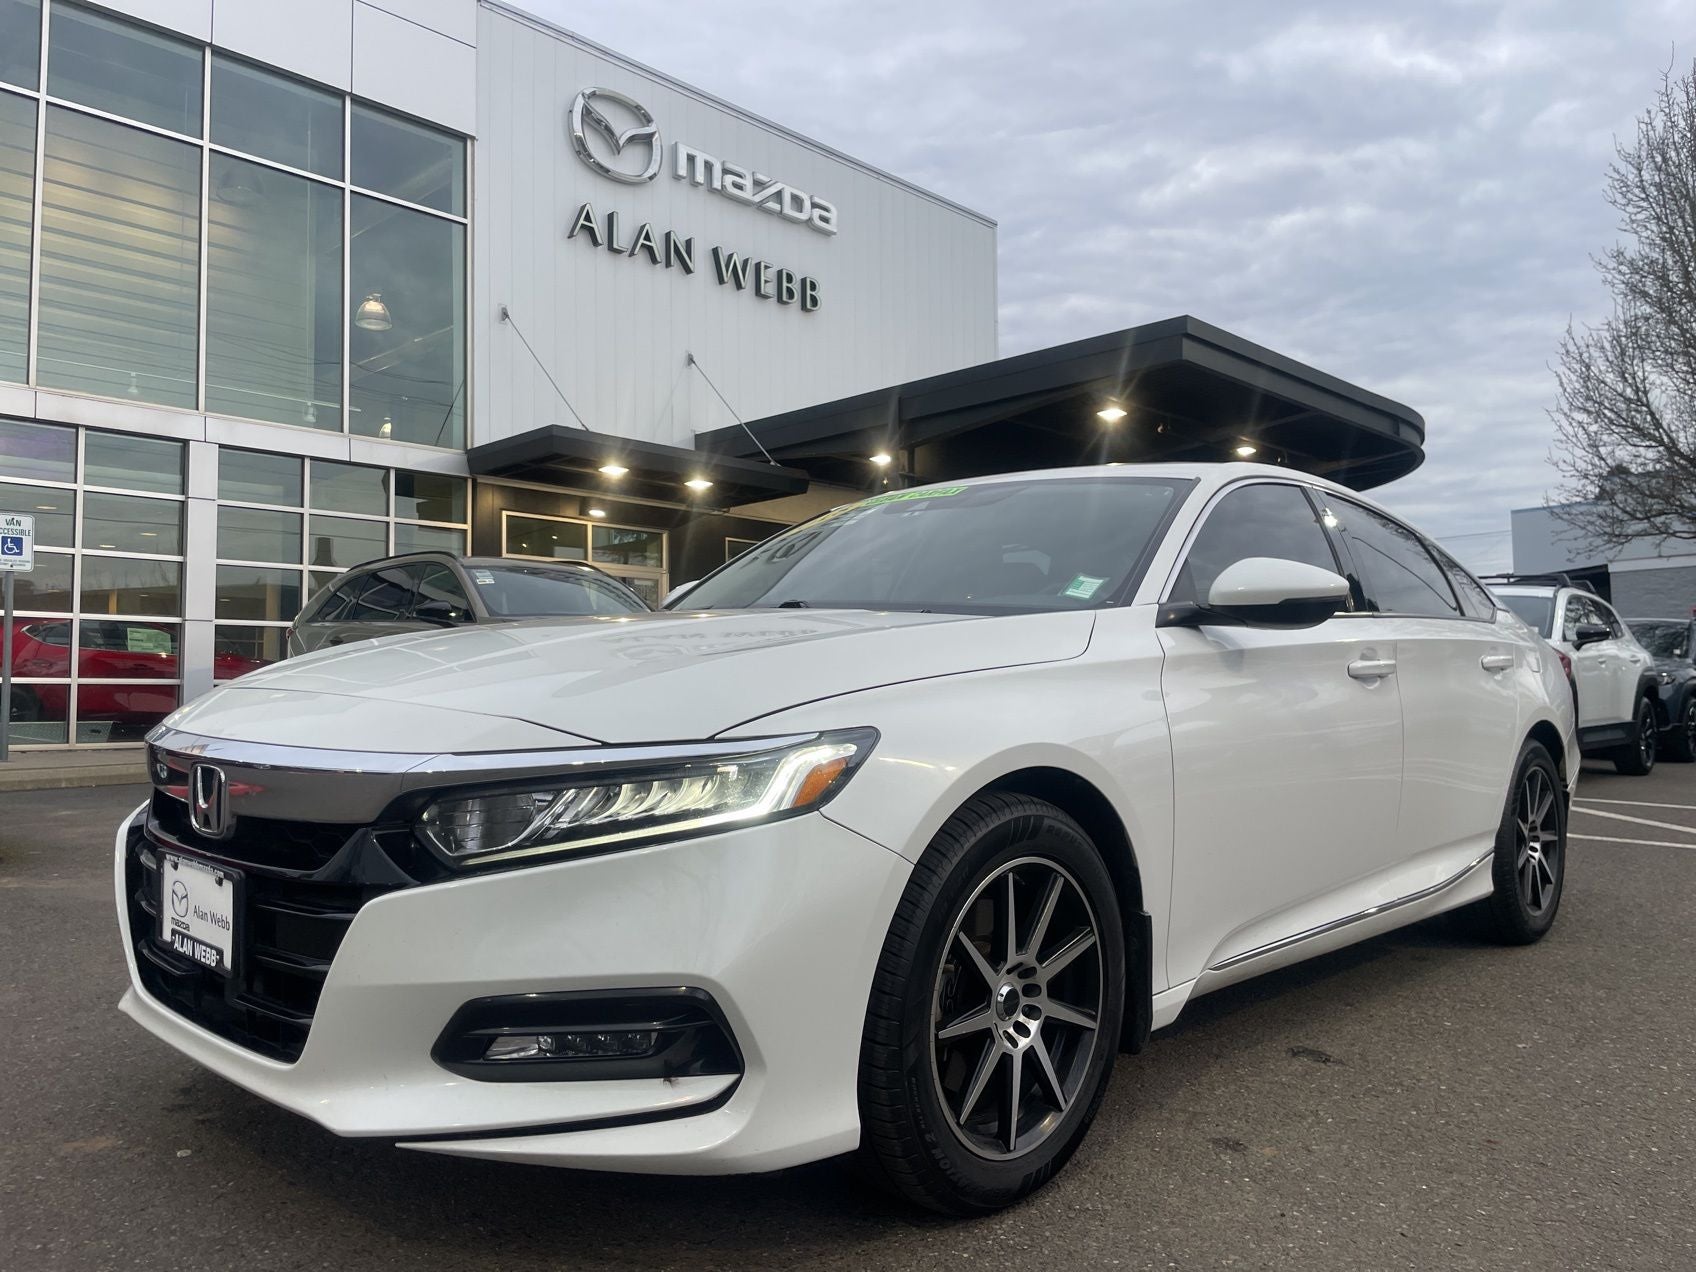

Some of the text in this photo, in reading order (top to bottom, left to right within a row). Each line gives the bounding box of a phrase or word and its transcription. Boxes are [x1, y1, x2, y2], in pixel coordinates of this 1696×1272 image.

[567, 203, 822, 313] ALAN WEBB
[0, 527, 31, 536] CCESSIBLE
[5, 518, 22, 527] VAN
[193, 905, 230, 931] Alan Webb
[174, 934, 217, 966] ALAN WEBB
